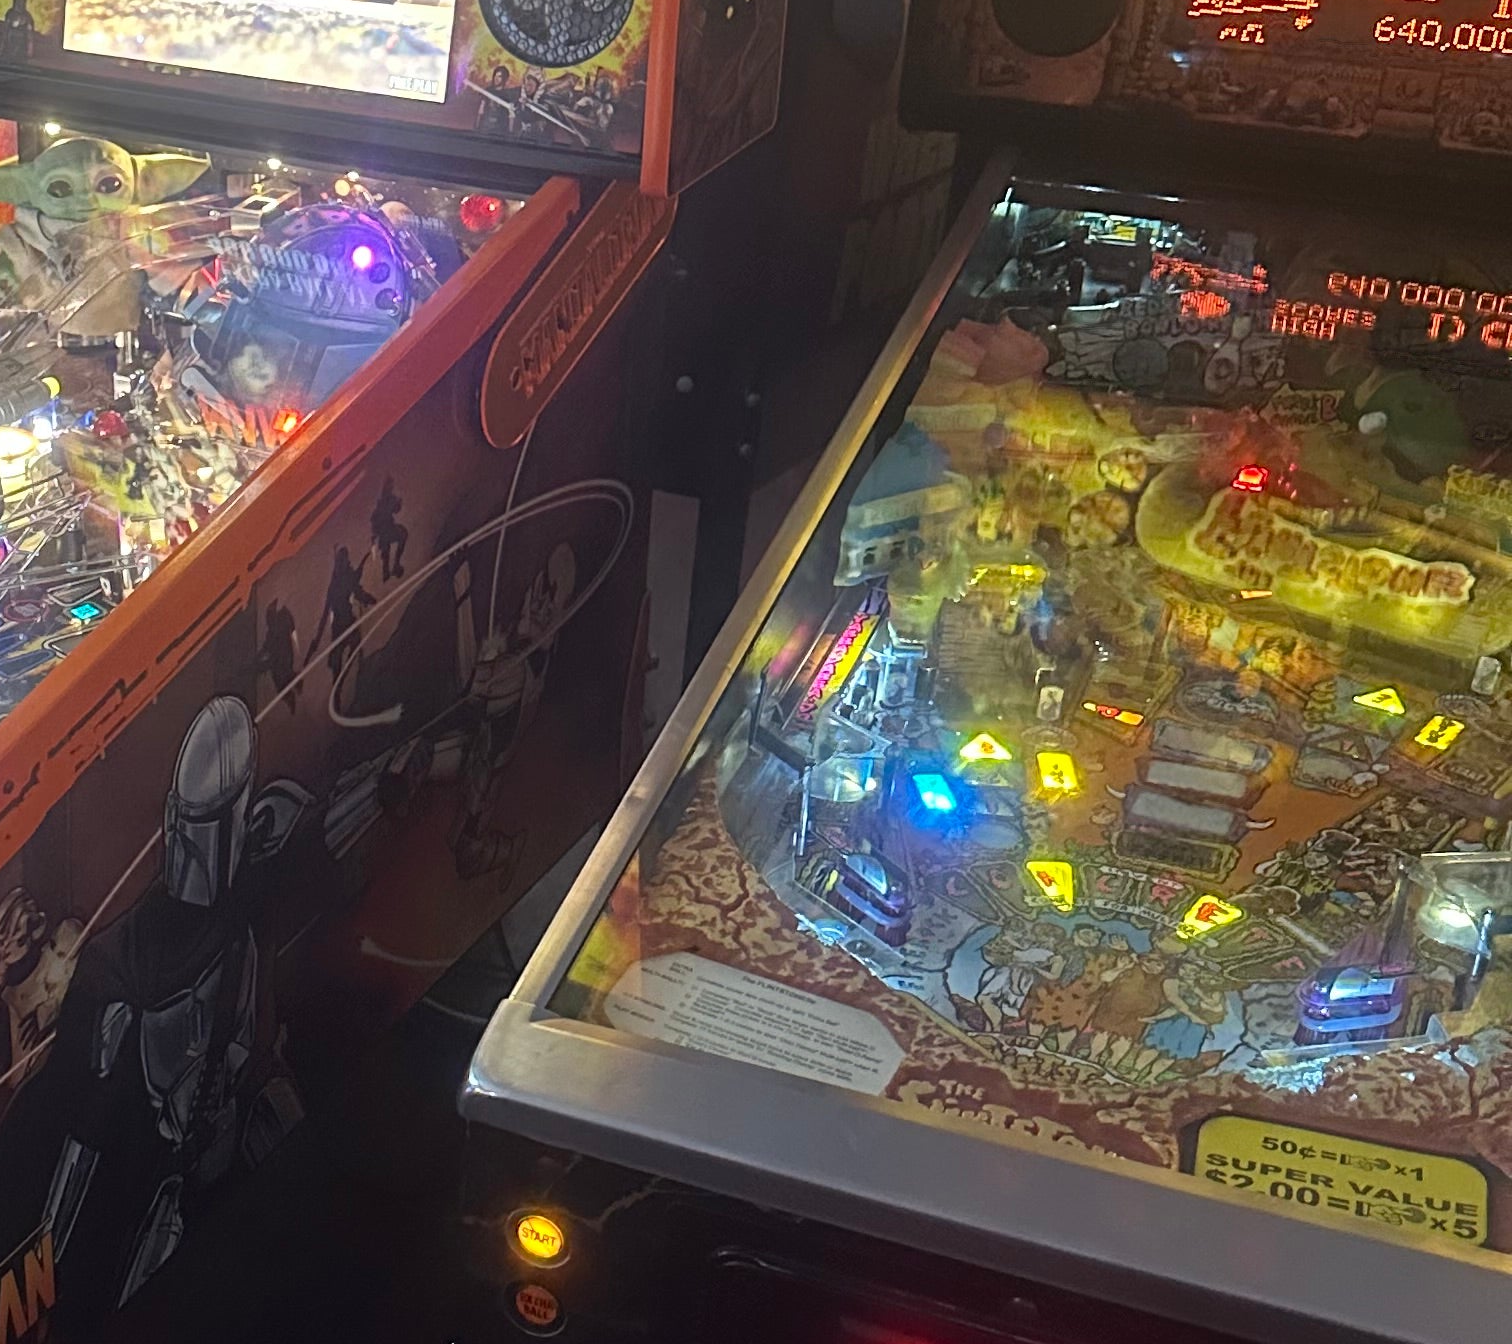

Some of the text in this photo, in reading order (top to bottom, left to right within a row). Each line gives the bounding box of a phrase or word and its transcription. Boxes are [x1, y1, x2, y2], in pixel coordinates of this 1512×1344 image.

[1204, 1152, 1479, 1220] SUPER VALUE
[521, 1227, 557, 1247] START
